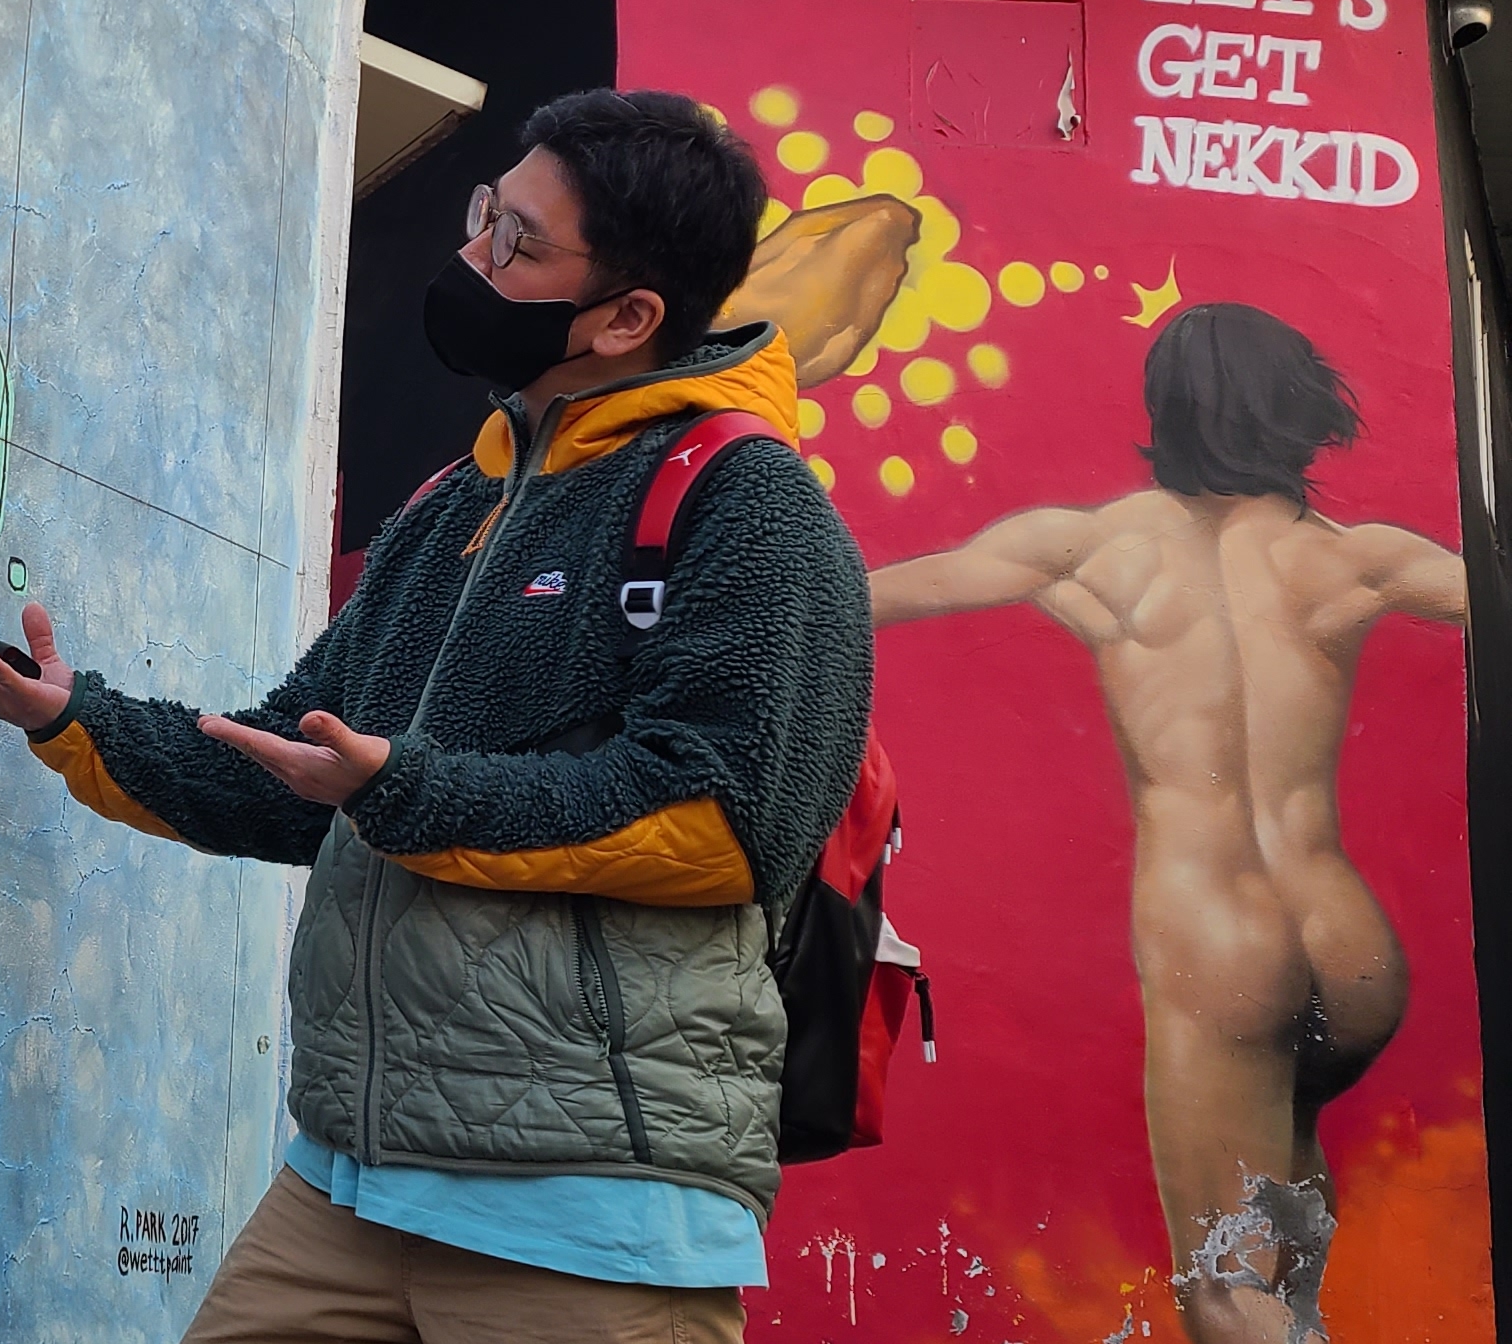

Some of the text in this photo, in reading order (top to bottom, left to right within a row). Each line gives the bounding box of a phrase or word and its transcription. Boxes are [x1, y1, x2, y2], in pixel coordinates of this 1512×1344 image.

[1138, 23, 1323, 106] GET
[1131, 115, 1420, 207] NEKKID
[171, 1212, 199, 1246] 2017
[117, 1246, 193, 1284] @wetttpaint
